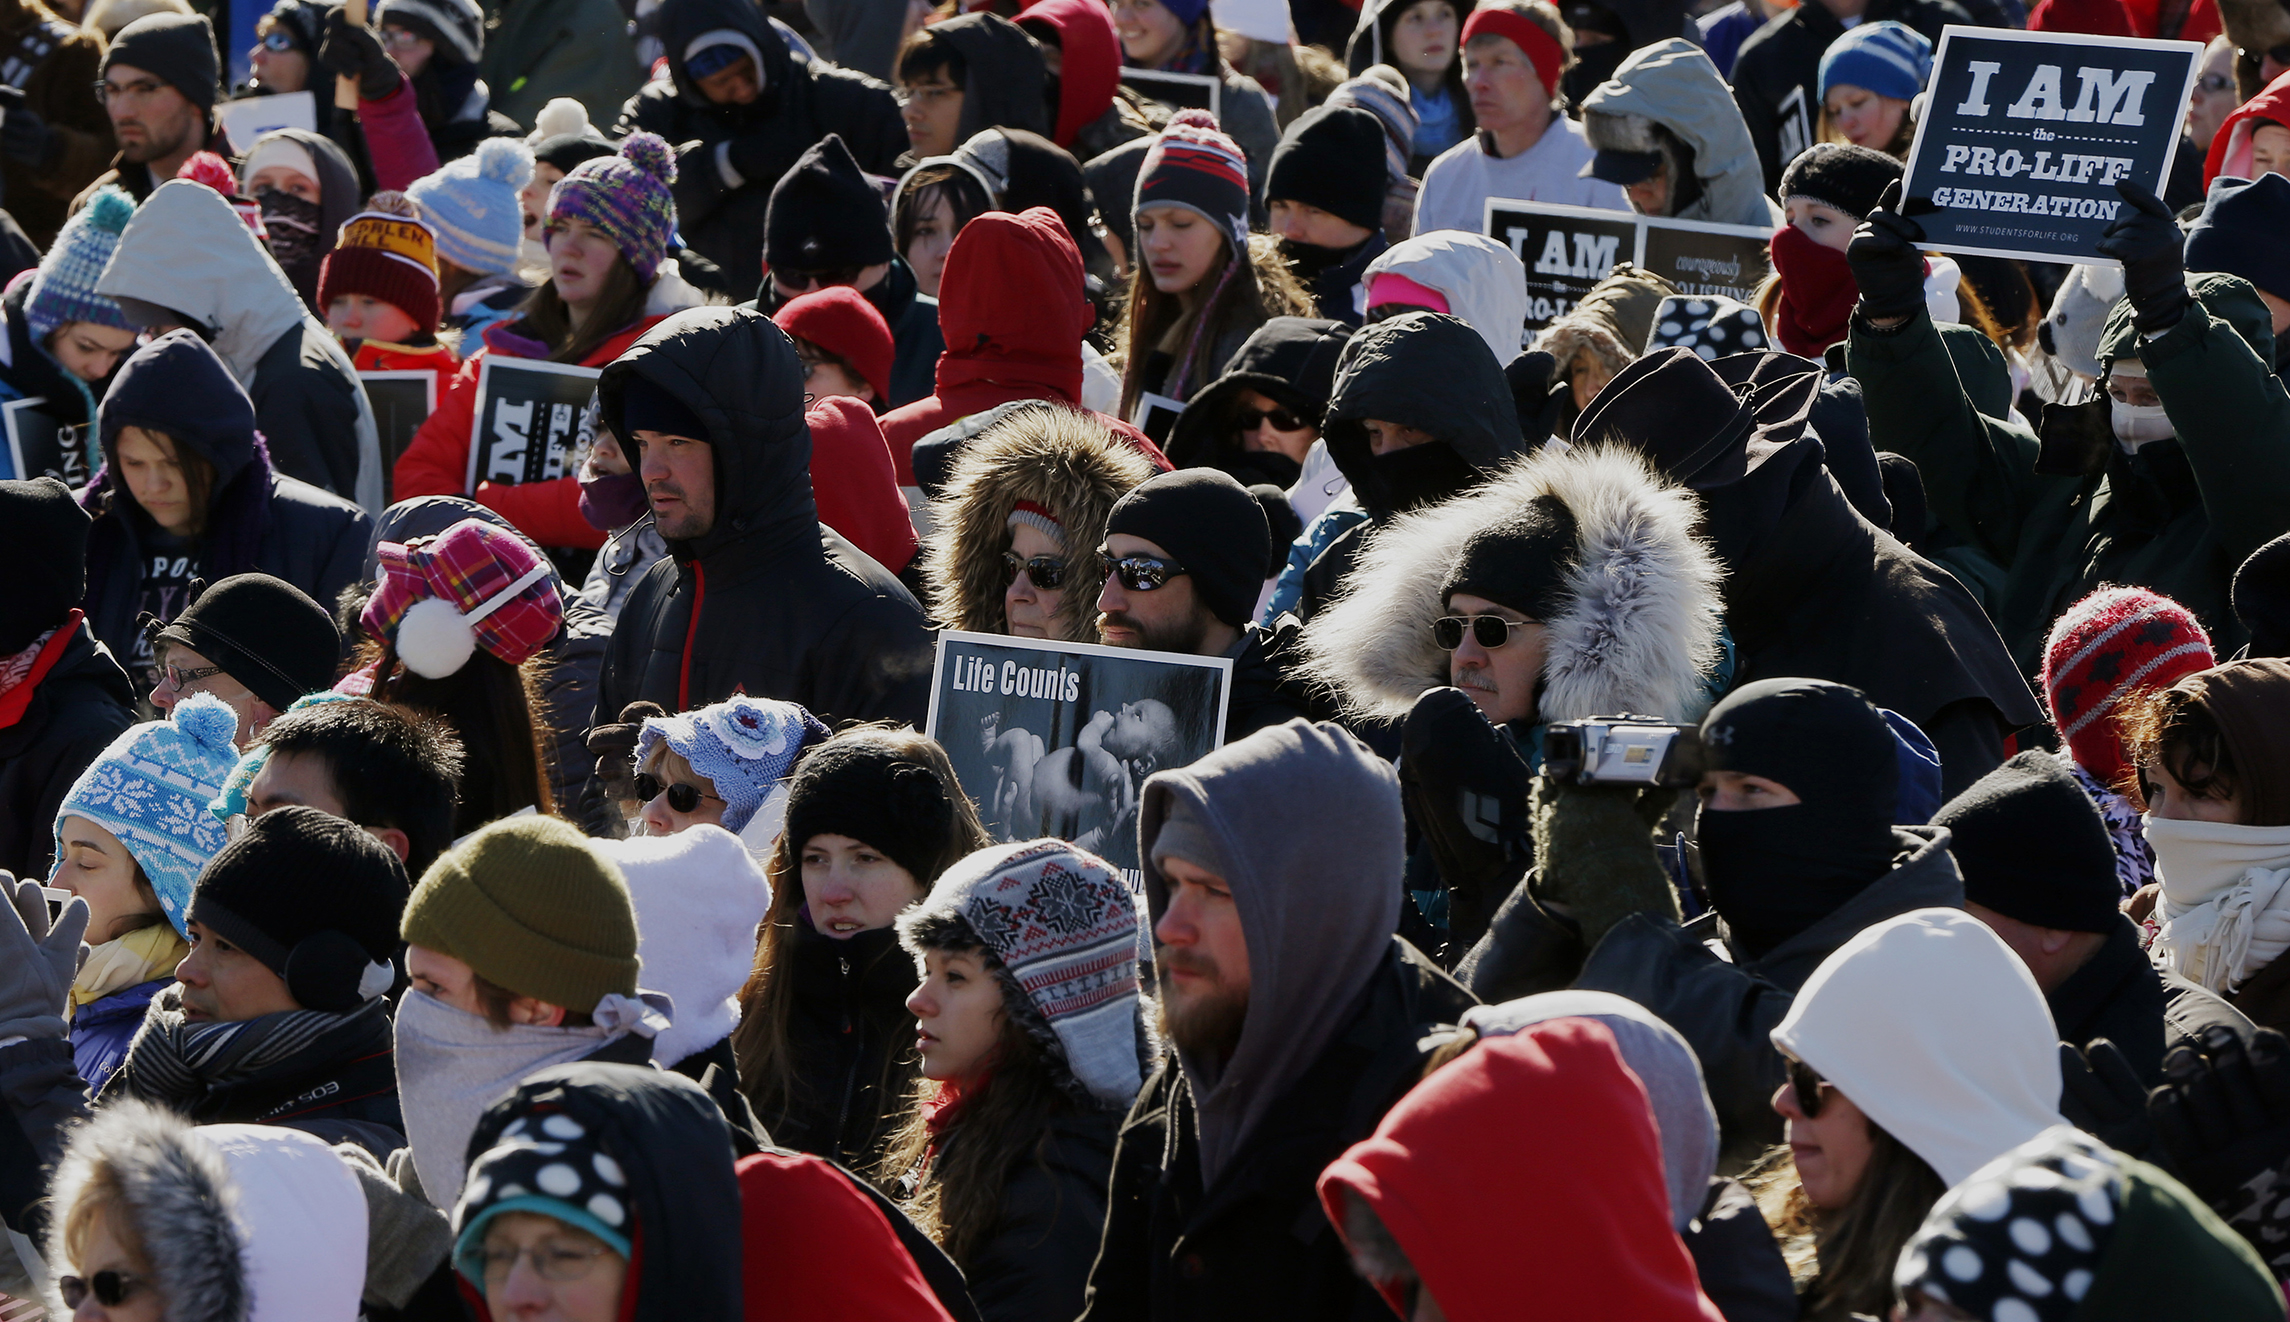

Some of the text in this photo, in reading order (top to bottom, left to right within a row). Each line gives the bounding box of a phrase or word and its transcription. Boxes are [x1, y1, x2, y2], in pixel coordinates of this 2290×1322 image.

[1956, 61, 2157, 126] I AM
[2032, 127, 2056, 142] the
[1940, 144, 2134, 186] PRO-LIFE
[1932, 187, 2121, 220] GENERATION
[1506, 226, 1620, 281] I AM
[1955, 224, 2079, 242] WWW.STUDENTSFORLIFE.ORG
[953, 655, 1080, 703] Life Counts
